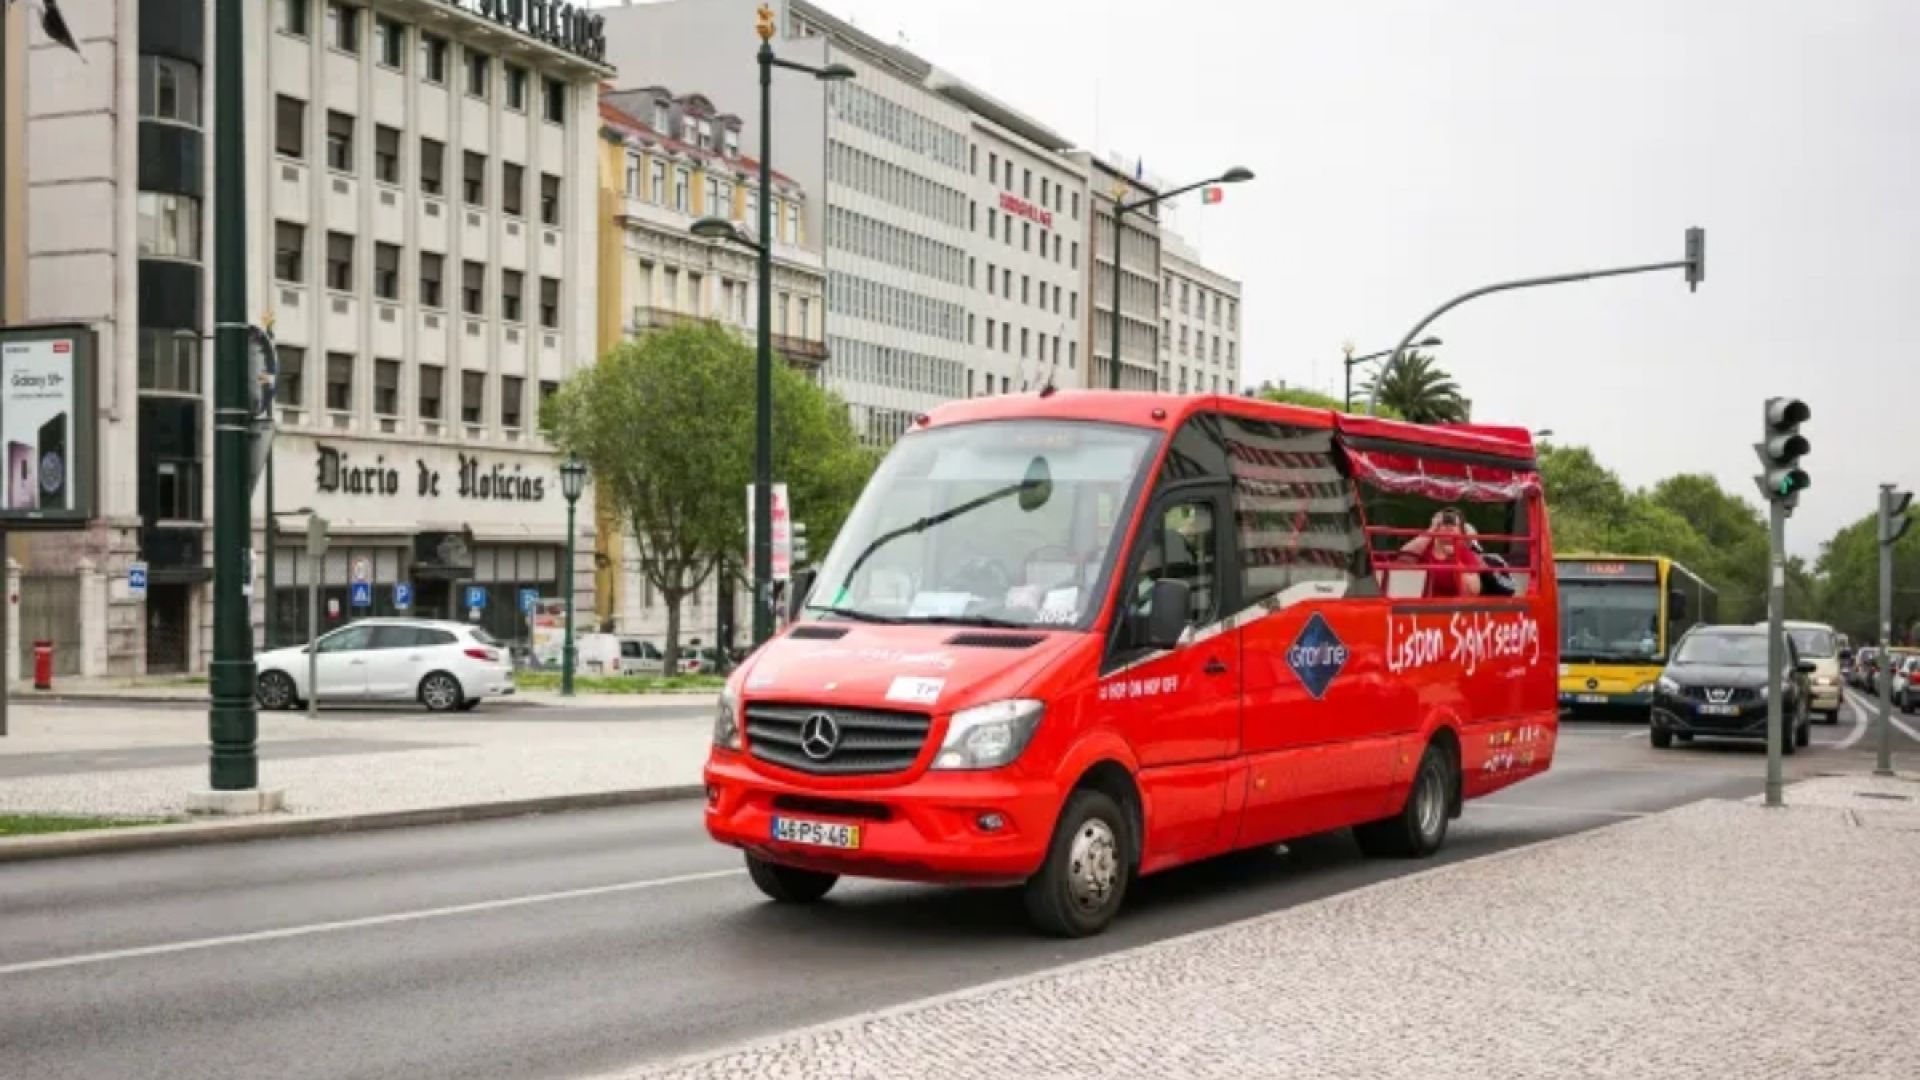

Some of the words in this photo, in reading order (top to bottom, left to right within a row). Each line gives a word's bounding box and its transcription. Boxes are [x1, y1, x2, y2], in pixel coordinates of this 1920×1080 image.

[315, 441, 399, 496] Diario
[416, 459, 441, 498] de
[458, 451, 545, 501] Noticias
[1386, 613, 1444, 674] Lisbon
[1450, 611, 1540, 677] Sightseeing
